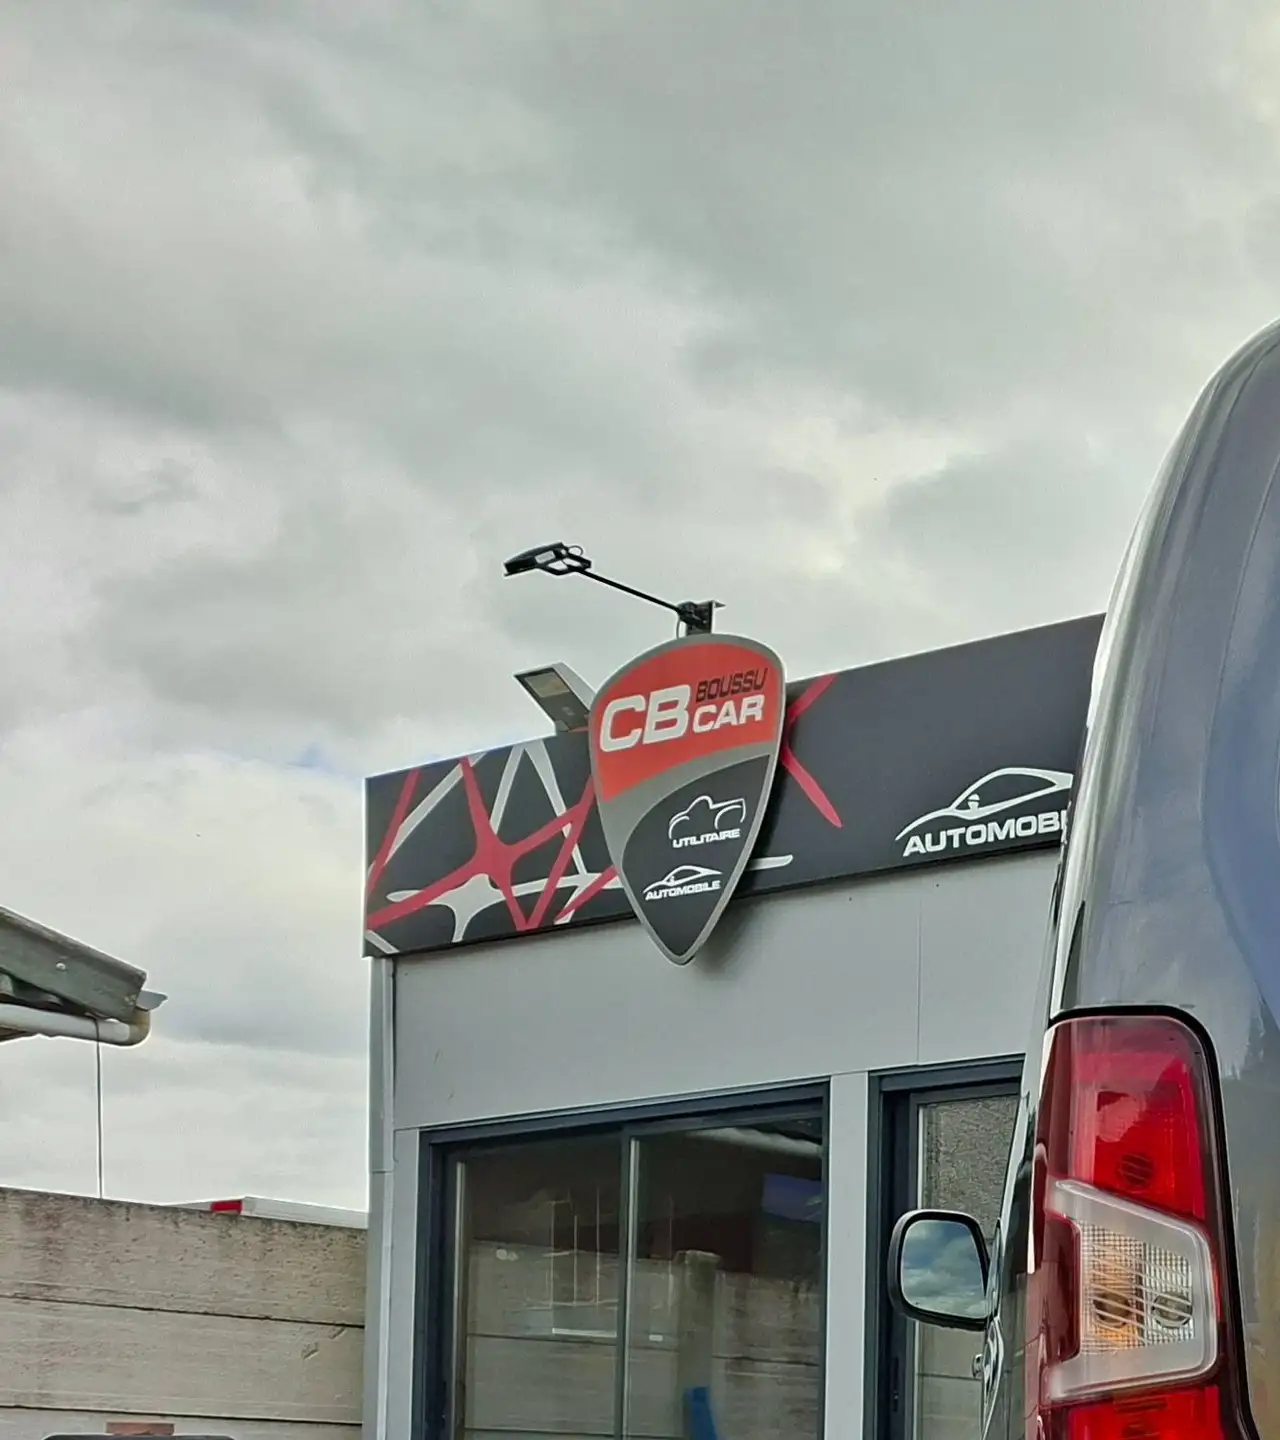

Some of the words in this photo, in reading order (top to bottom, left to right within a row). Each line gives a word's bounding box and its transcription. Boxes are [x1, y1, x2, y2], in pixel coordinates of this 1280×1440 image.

[696, 668, 768, 703] BOUSSU
[600, 684, 691, 752] CB
[692, 694, 766, 734] CAR
[672, 828, 741, 848] UTILITAIRE
[645, 880, 721, 900] AUTOMOBILE
